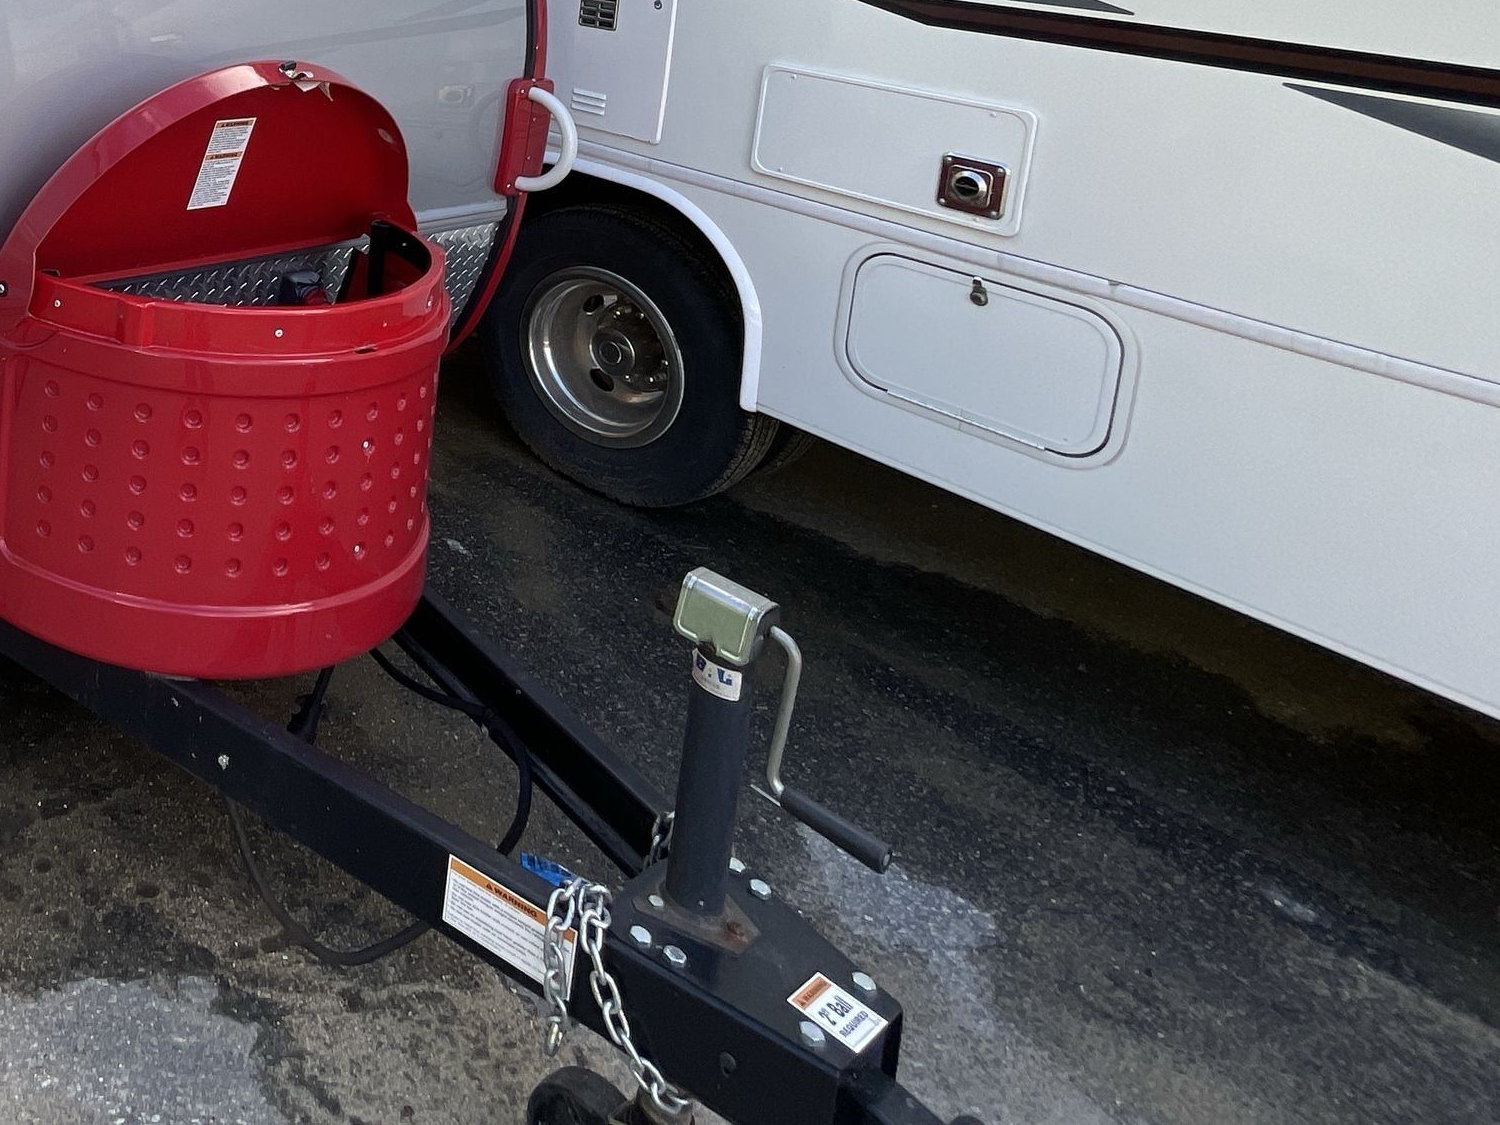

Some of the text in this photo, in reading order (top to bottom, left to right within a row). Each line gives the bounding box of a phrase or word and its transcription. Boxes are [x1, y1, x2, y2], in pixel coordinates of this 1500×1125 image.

[494, 886, 539, 918] WARNING
[826, 995, 854, 1018] Ball
[839, 1010, 869, 1037] REQUIRED
